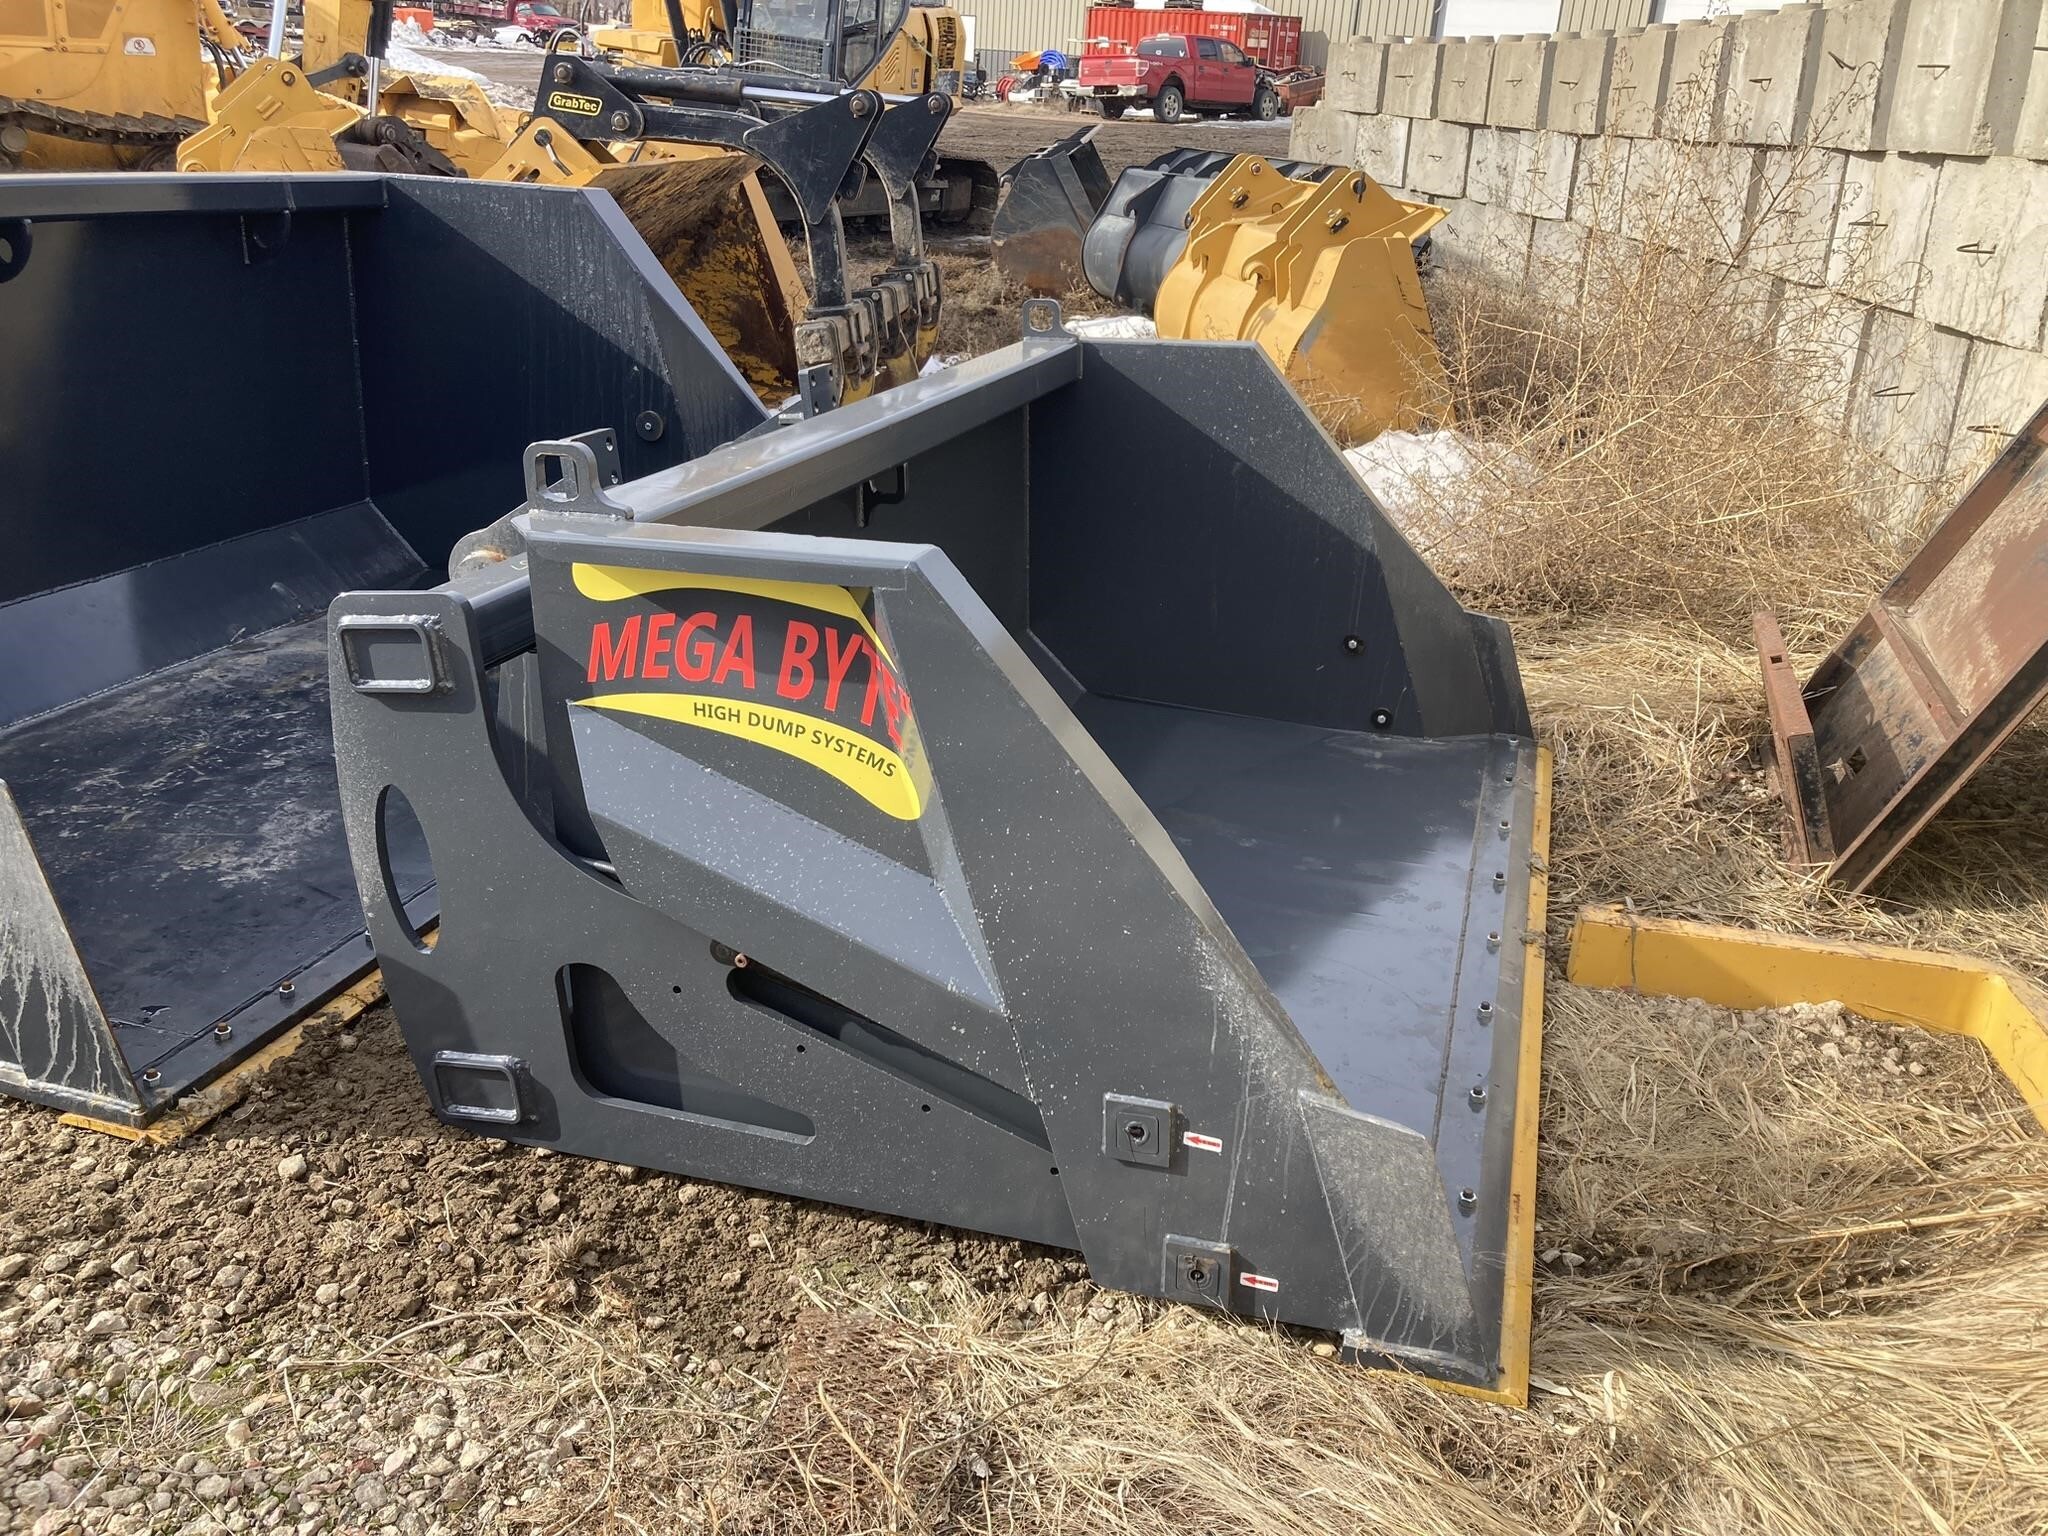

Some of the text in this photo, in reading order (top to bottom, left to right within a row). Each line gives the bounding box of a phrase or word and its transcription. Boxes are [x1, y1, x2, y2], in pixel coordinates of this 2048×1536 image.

[553, 95, 598, 112] GrabTec
[587, 612, 756, 690] MEGA
[693, 702, 897, 777] HIGH DUMP SYSTEMS
